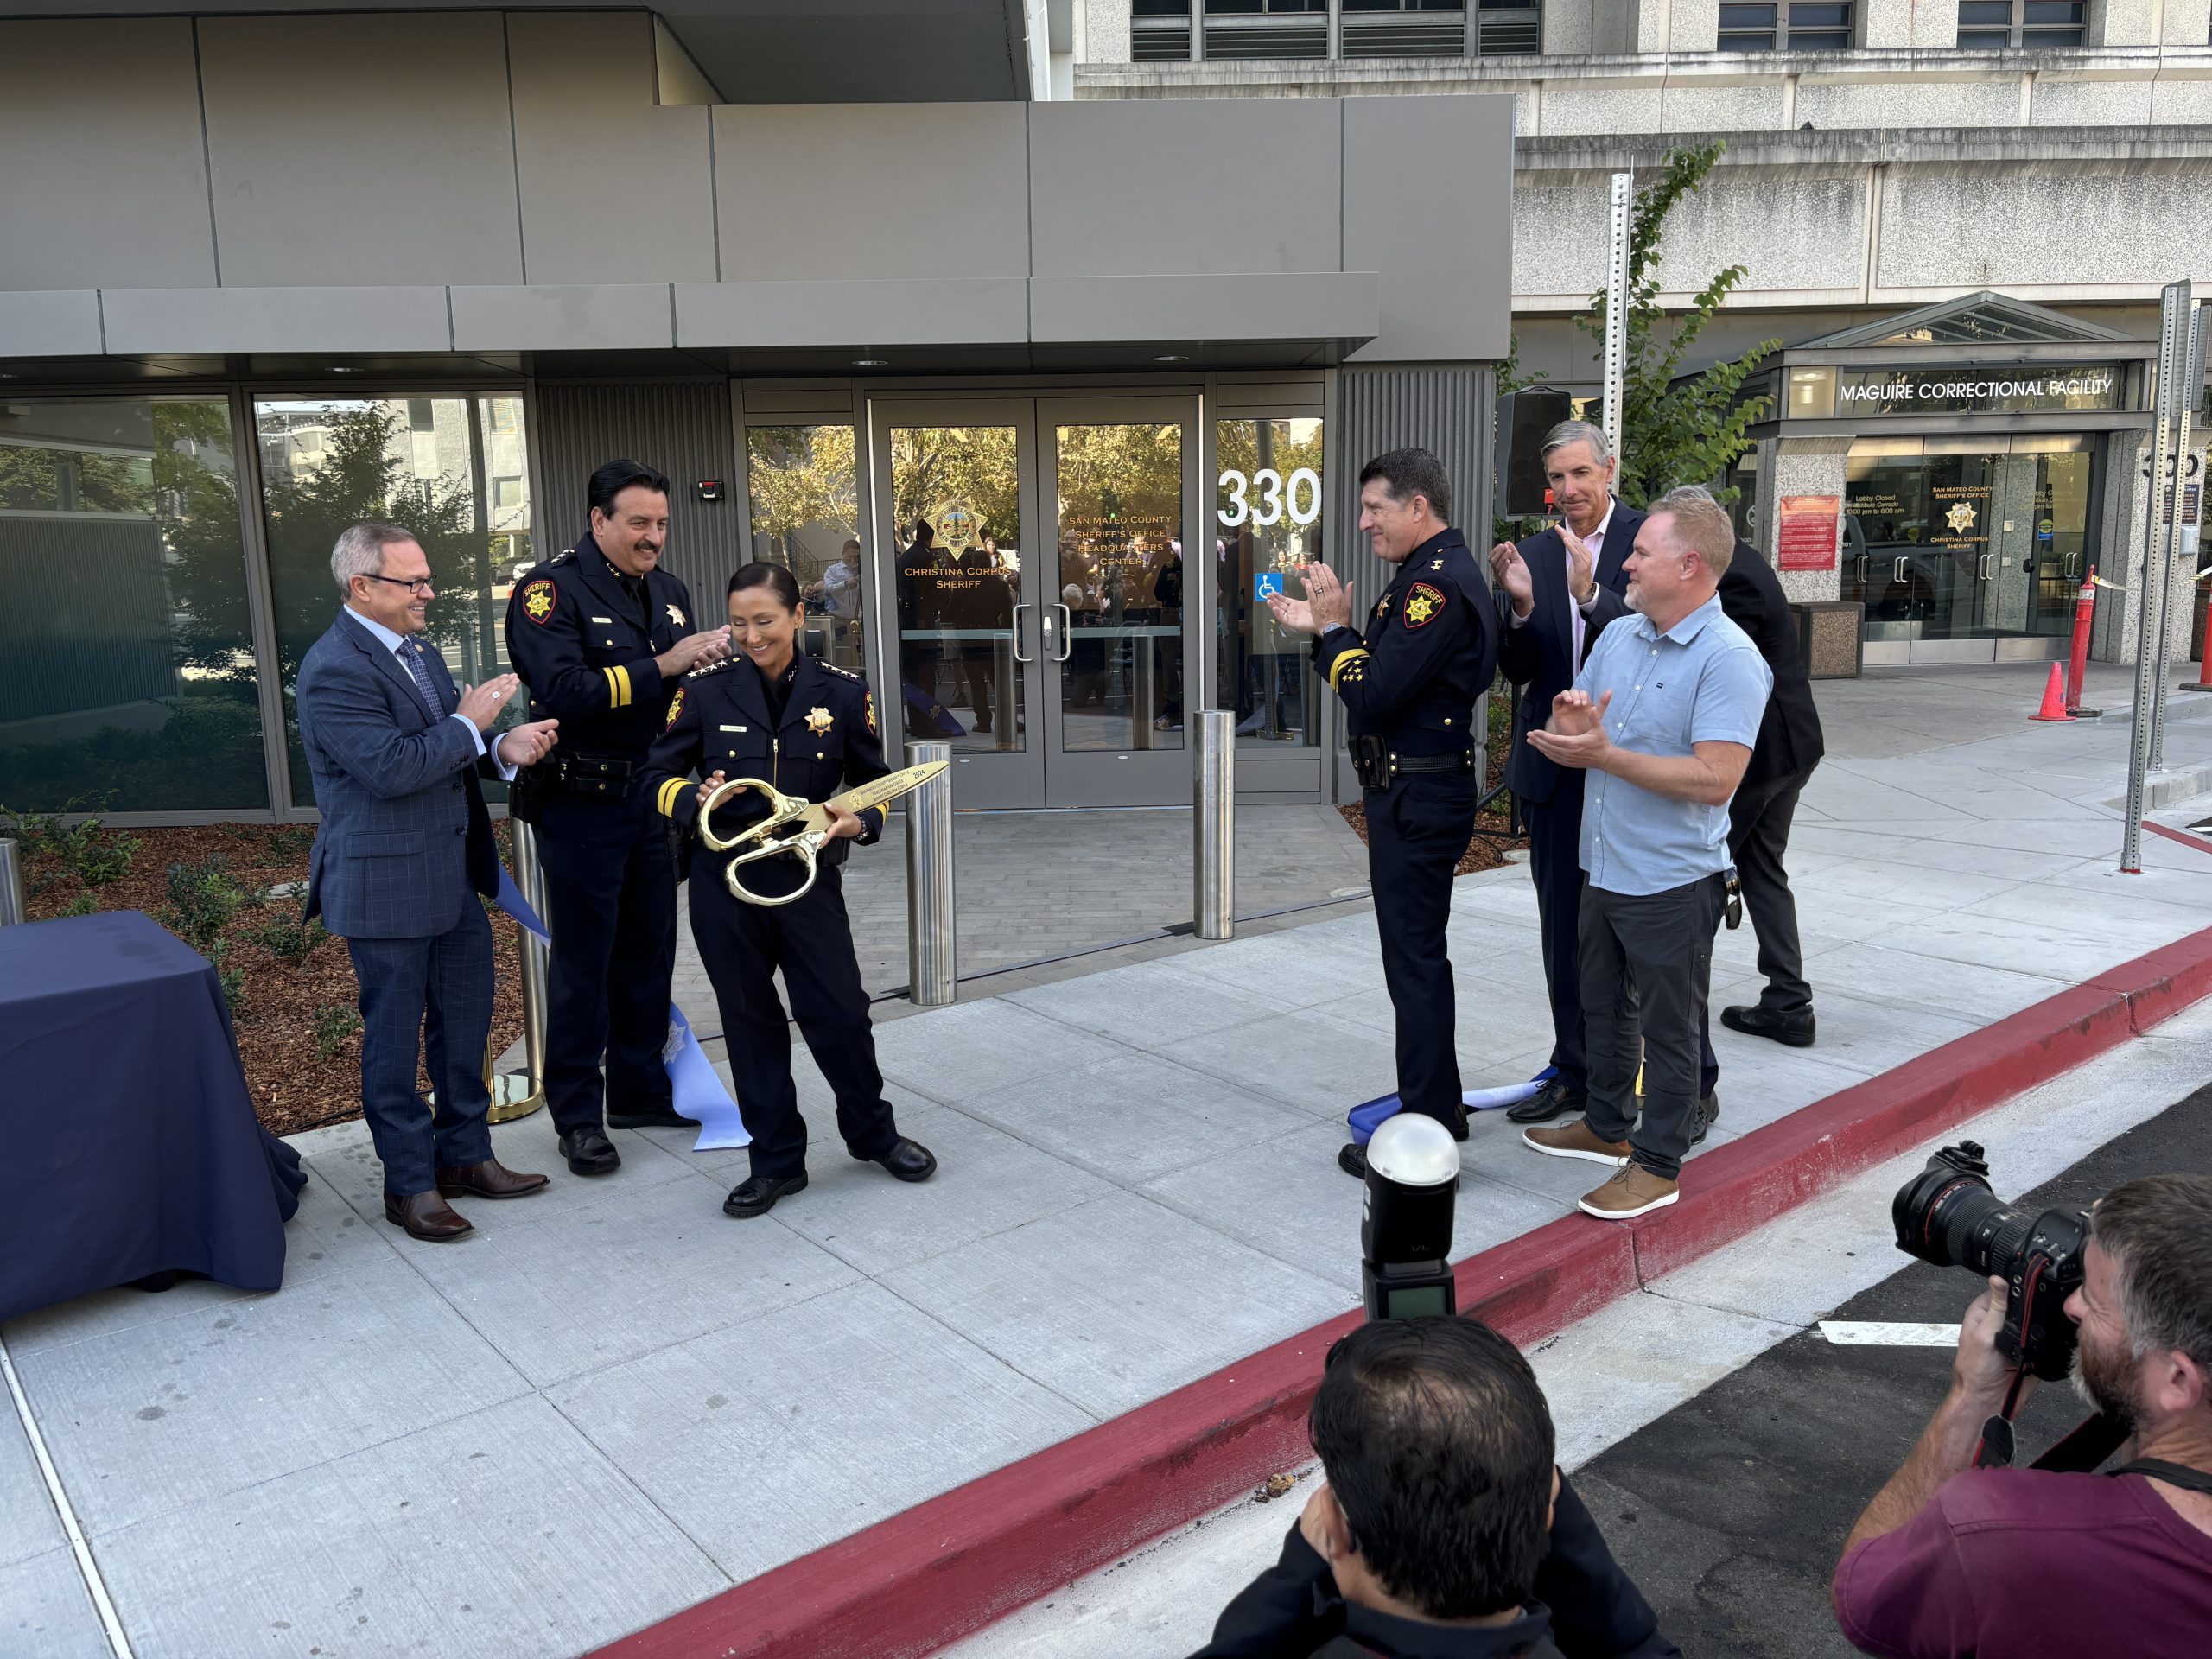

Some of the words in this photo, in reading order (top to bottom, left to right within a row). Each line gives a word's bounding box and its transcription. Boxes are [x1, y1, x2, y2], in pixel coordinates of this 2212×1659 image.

[1840, 384, 1914, 401] MAGUIRE
[1918, 381, 2045, 398] CORRECTIONAL
[2049, 378, 2113, 396] FACILITY
[1217, 467, 1322, 527] 330
[1069, 517, 1090, 525] SAN
[1092, 516, 1128, 524] MATEO
[1130, 515, 1173, 524] COUNTY
[1075, 531, 1126, 539] SHERIFF'S
[1128, 530, 1166, 538] OFFICE
[1099, 557, 1142, 566] CENTER
[904, 568, 964, 576] CHRISTINA
[966, 567, 1012, 575] CORPUS
[524, 582, 551, 597] SHERIFF
[936, 580, 982, 589] SHERIFF
[1415, 585, 1443, 604] SHERIFF
[912, 769, 925, 779] 2024
